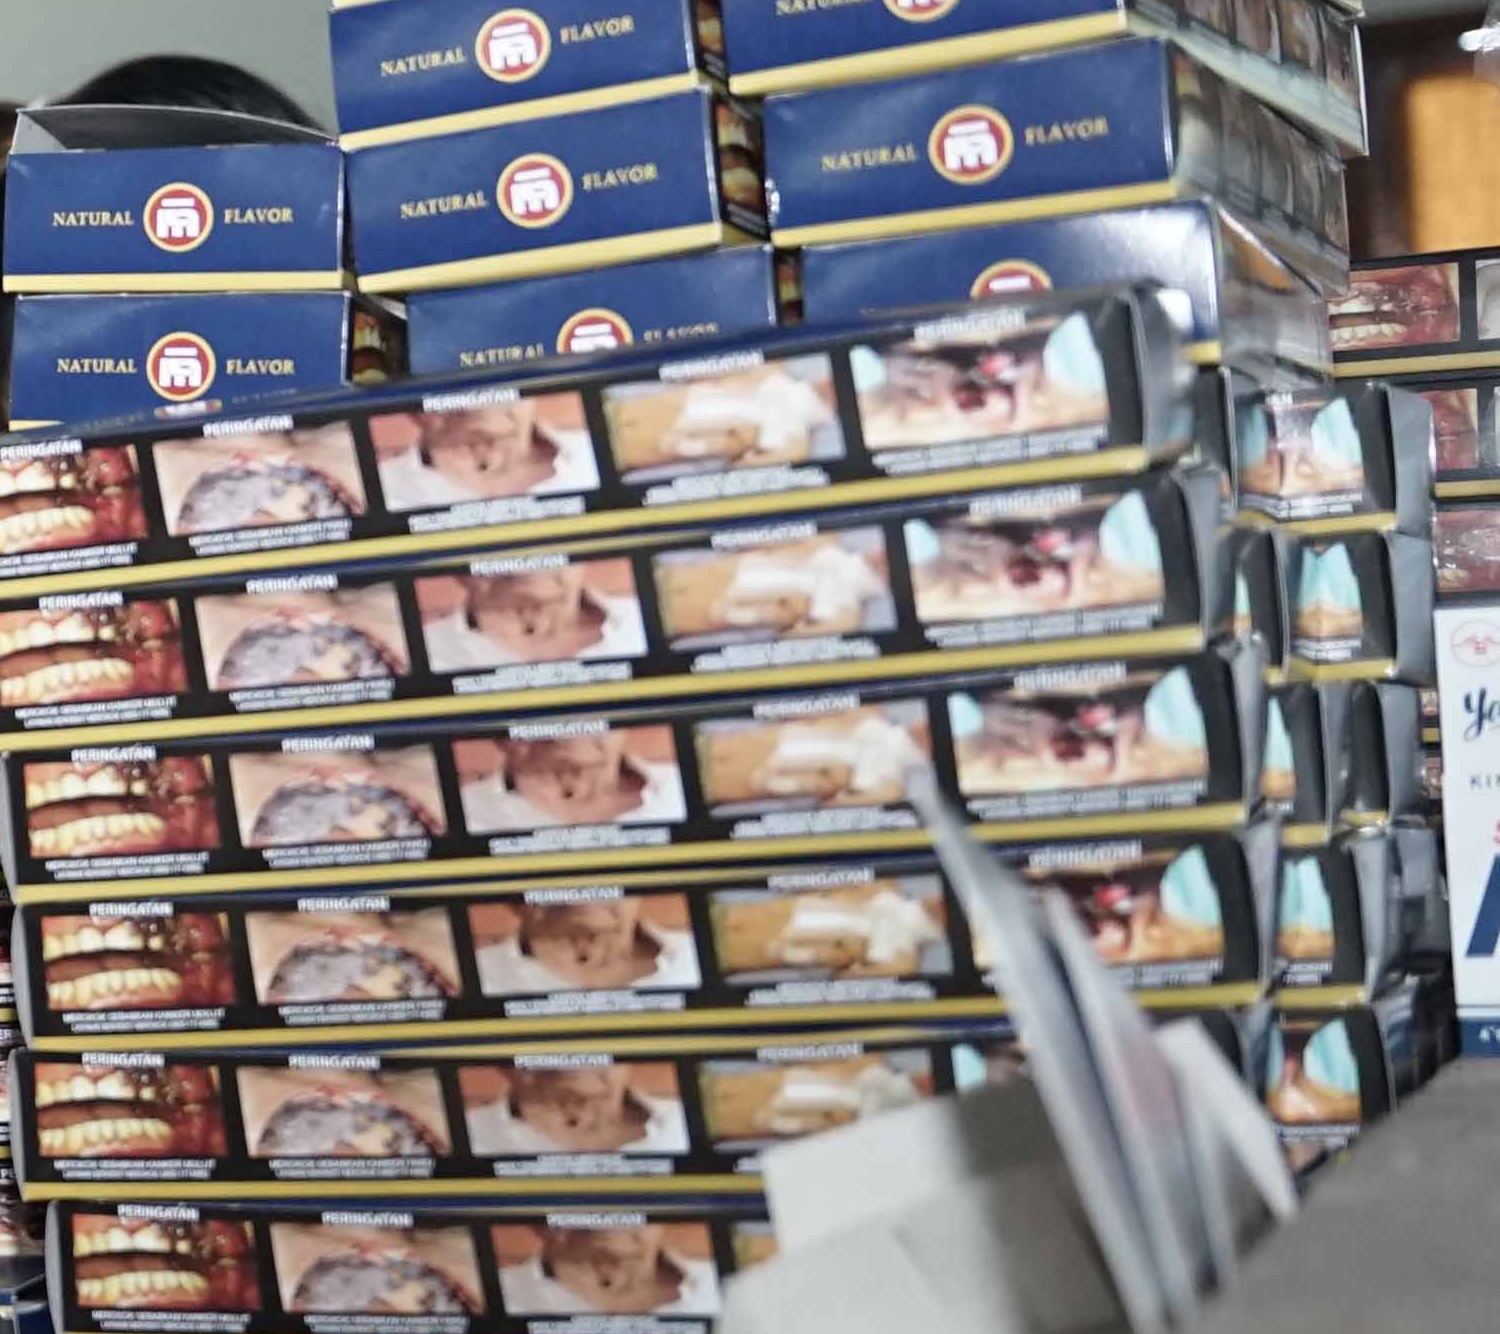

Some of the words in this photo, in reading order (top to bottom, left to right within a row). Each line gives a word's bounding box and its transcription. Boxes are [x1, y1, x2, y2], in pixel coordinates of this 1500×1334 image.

[380, 49, 464, 77] NATURAL
[560, 16, 633, 43] FLAVOR
[821, 142, 916, 172] NATURAL
[1024, 118, 1109, 145] FLAVOR
[400, 191, 488, 218] NATURAL
[582, 164, 657, 190] FLAVOR
[53, 209, 133, 226] NATURAL
[224, 207, 292, 223] FLAVOR
[57, 357, 136, 375] NATURAL
[225, 358, 294, 375] FLAVOR
[203, 415, 293, 437] PERINGATAN
[0, 440, 82, 459] PERINGATAN
[246, 574, 338, 594] PERINGATAN
[40, 592, 123, 610] PERINGATAN
[282, 735, 375, 752] PERINGATAN
[71, 747, 156, 763] PERINGATAN
[89, 902, 173, 917] PERINGATAN
[298, 896, 389, 912] PERINGATAN
[82, 1053, 164, 1067] PERINGATAN
[289, 1055, 380, 1069] PERINGATAN
[117, 1205, 199, 1220] PERINGATAN
[322, 1212, 413, 1226] PERINGATAN
